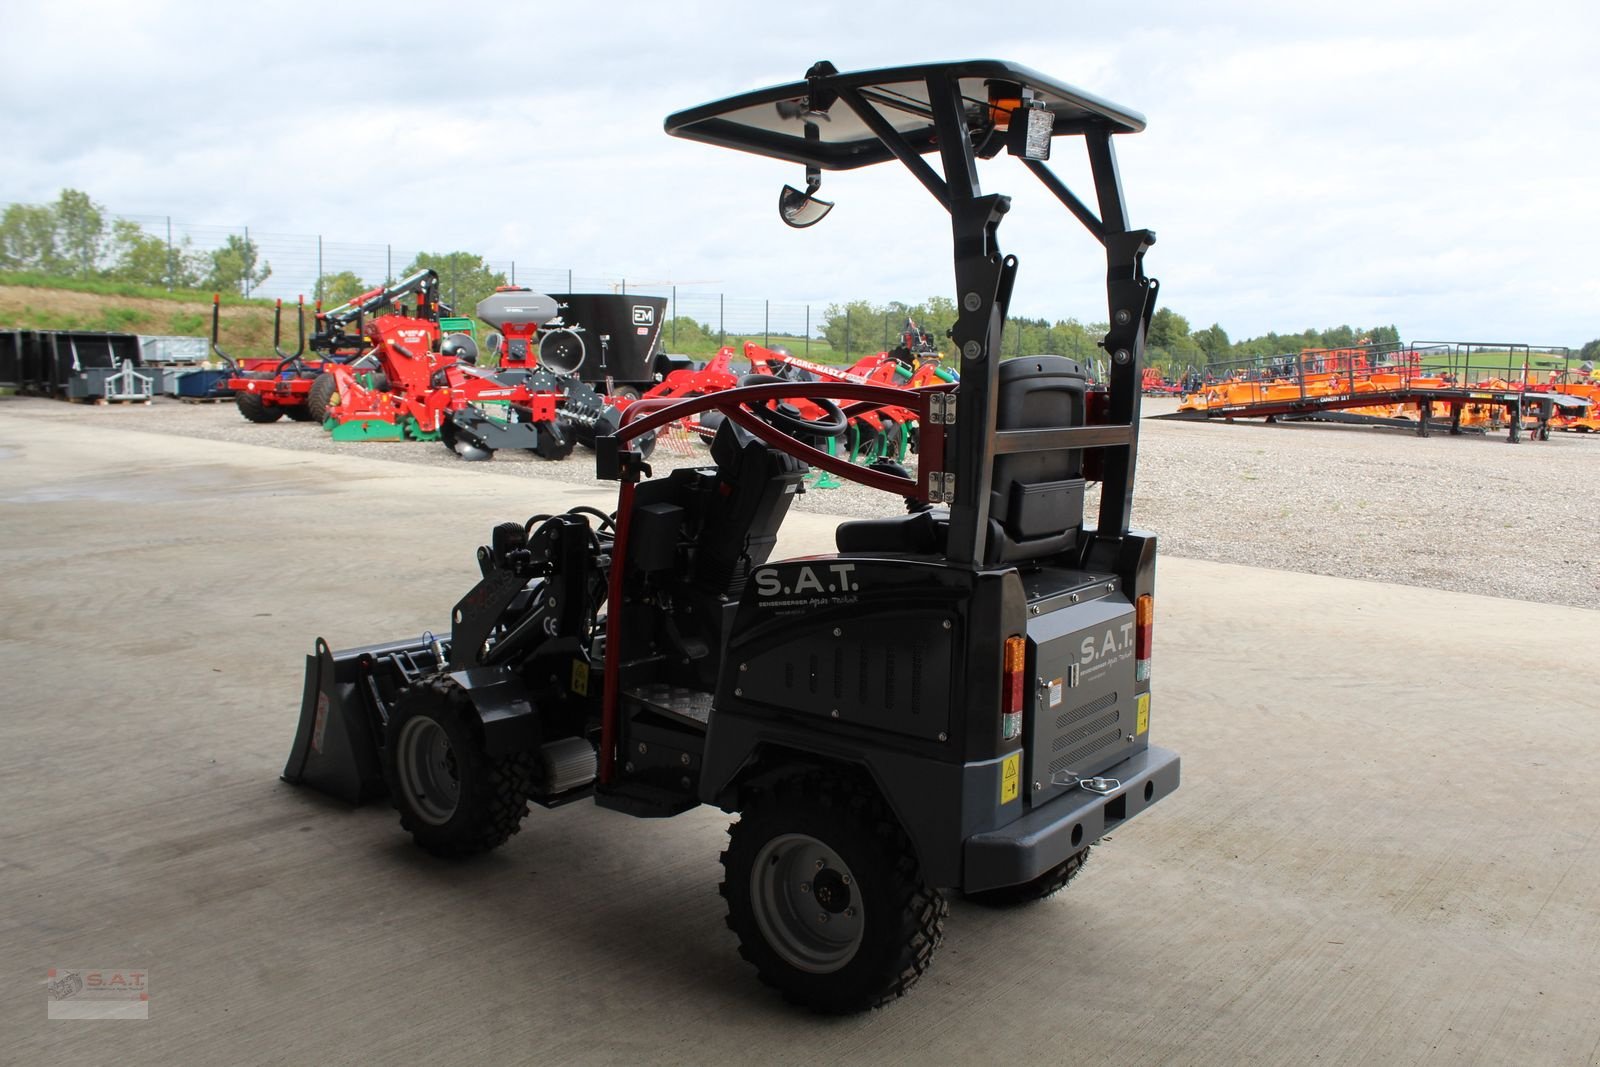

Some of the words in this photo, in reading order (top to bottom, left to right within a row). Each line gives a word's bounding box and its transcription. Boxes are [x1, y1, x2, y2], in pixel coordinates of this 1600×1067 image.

[790, 358, 839, 377] AGRO-MASZ
[755, 564, 859, 596] S.A.T.
[1081, 622, 1133, 664] S.A.T.
